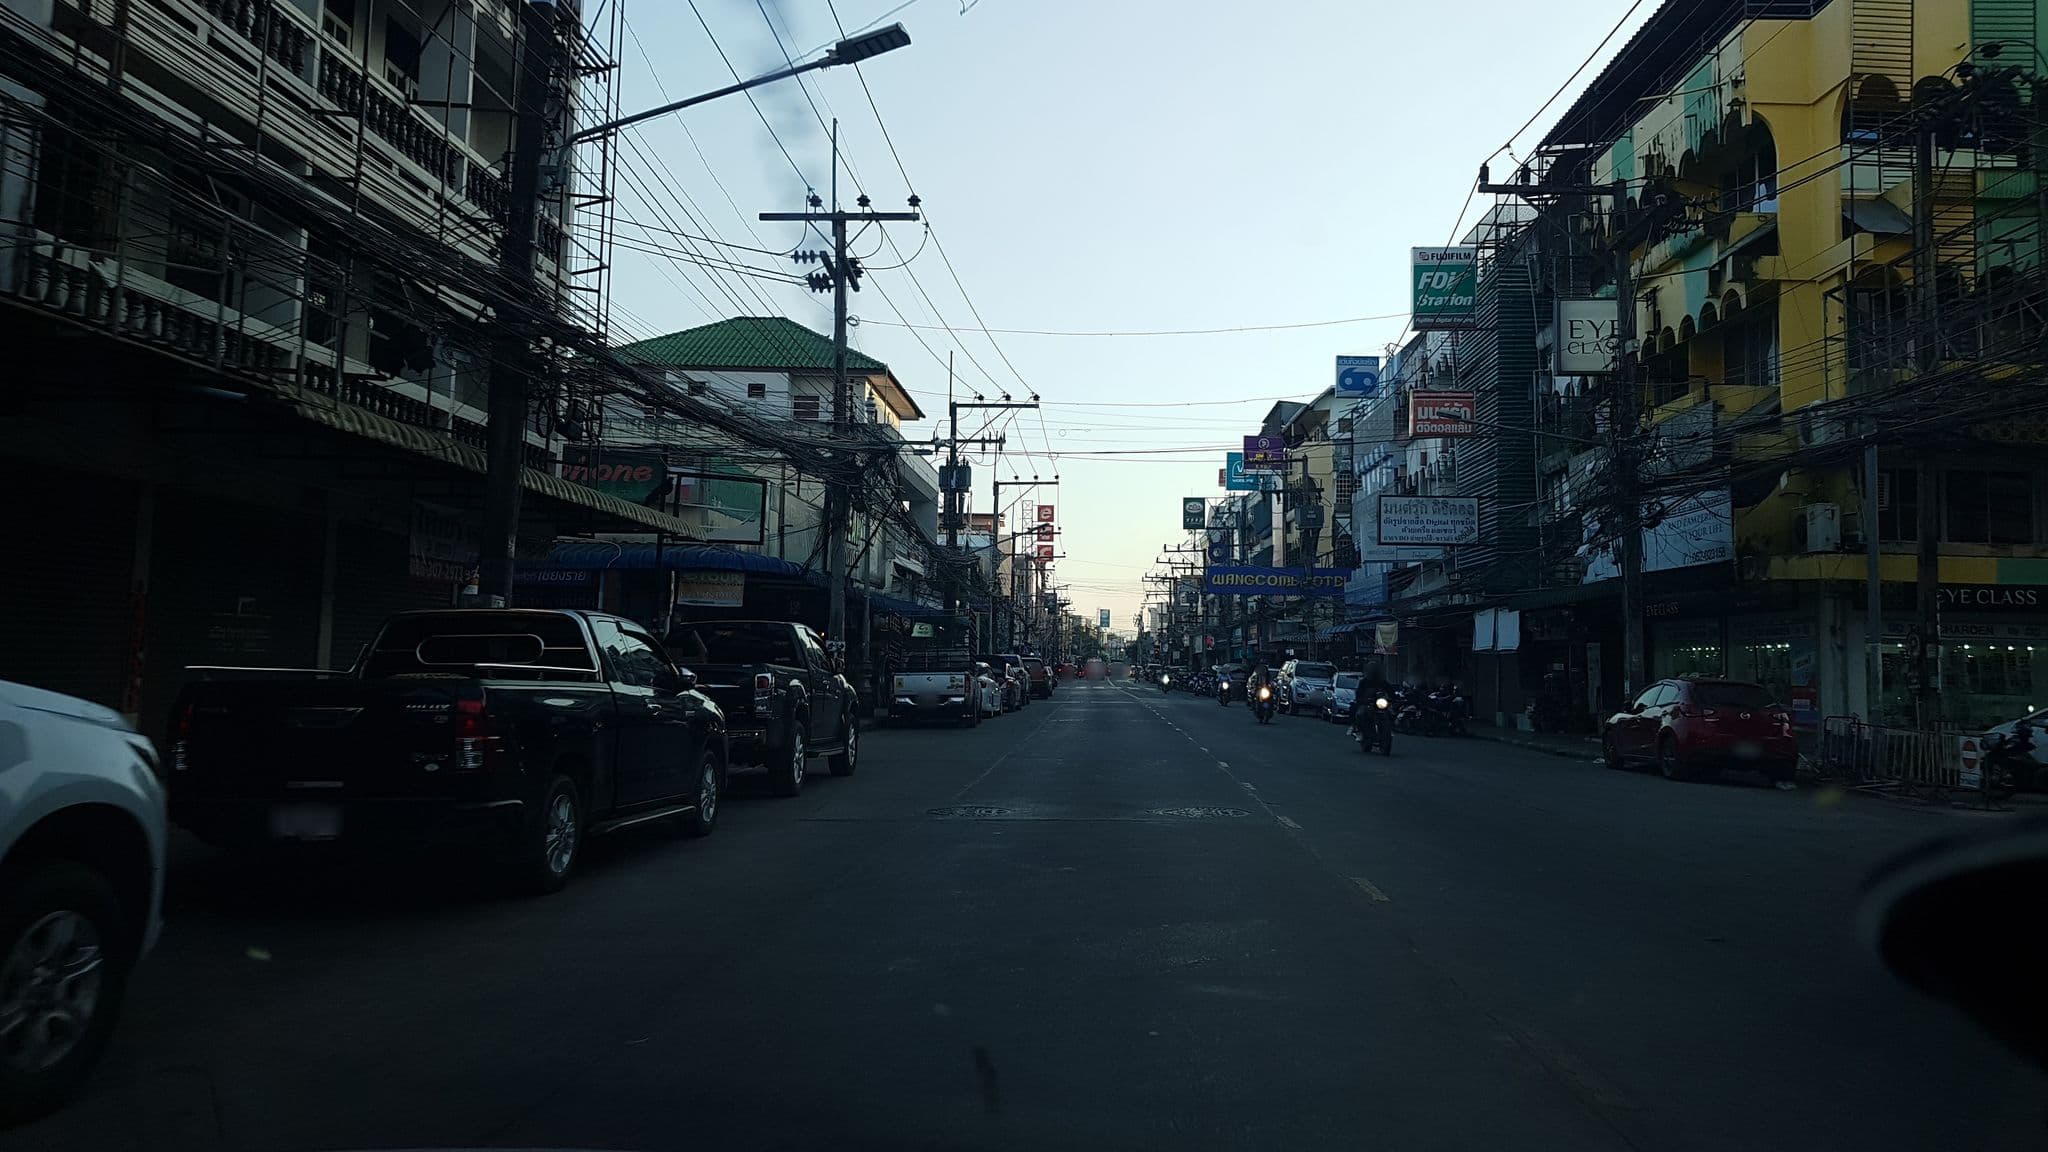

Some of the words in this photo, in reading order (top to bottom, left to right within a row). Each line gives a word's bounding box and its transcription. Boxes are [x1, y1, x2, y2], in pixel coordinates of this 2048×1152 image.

[1431, 252, 1471, 261] FUJIFILM
[1417, 294, 1474, 306] Station
[1568, 341, 1615, 355] CLAS
[1975, 588, 2038, 605] CLASS
